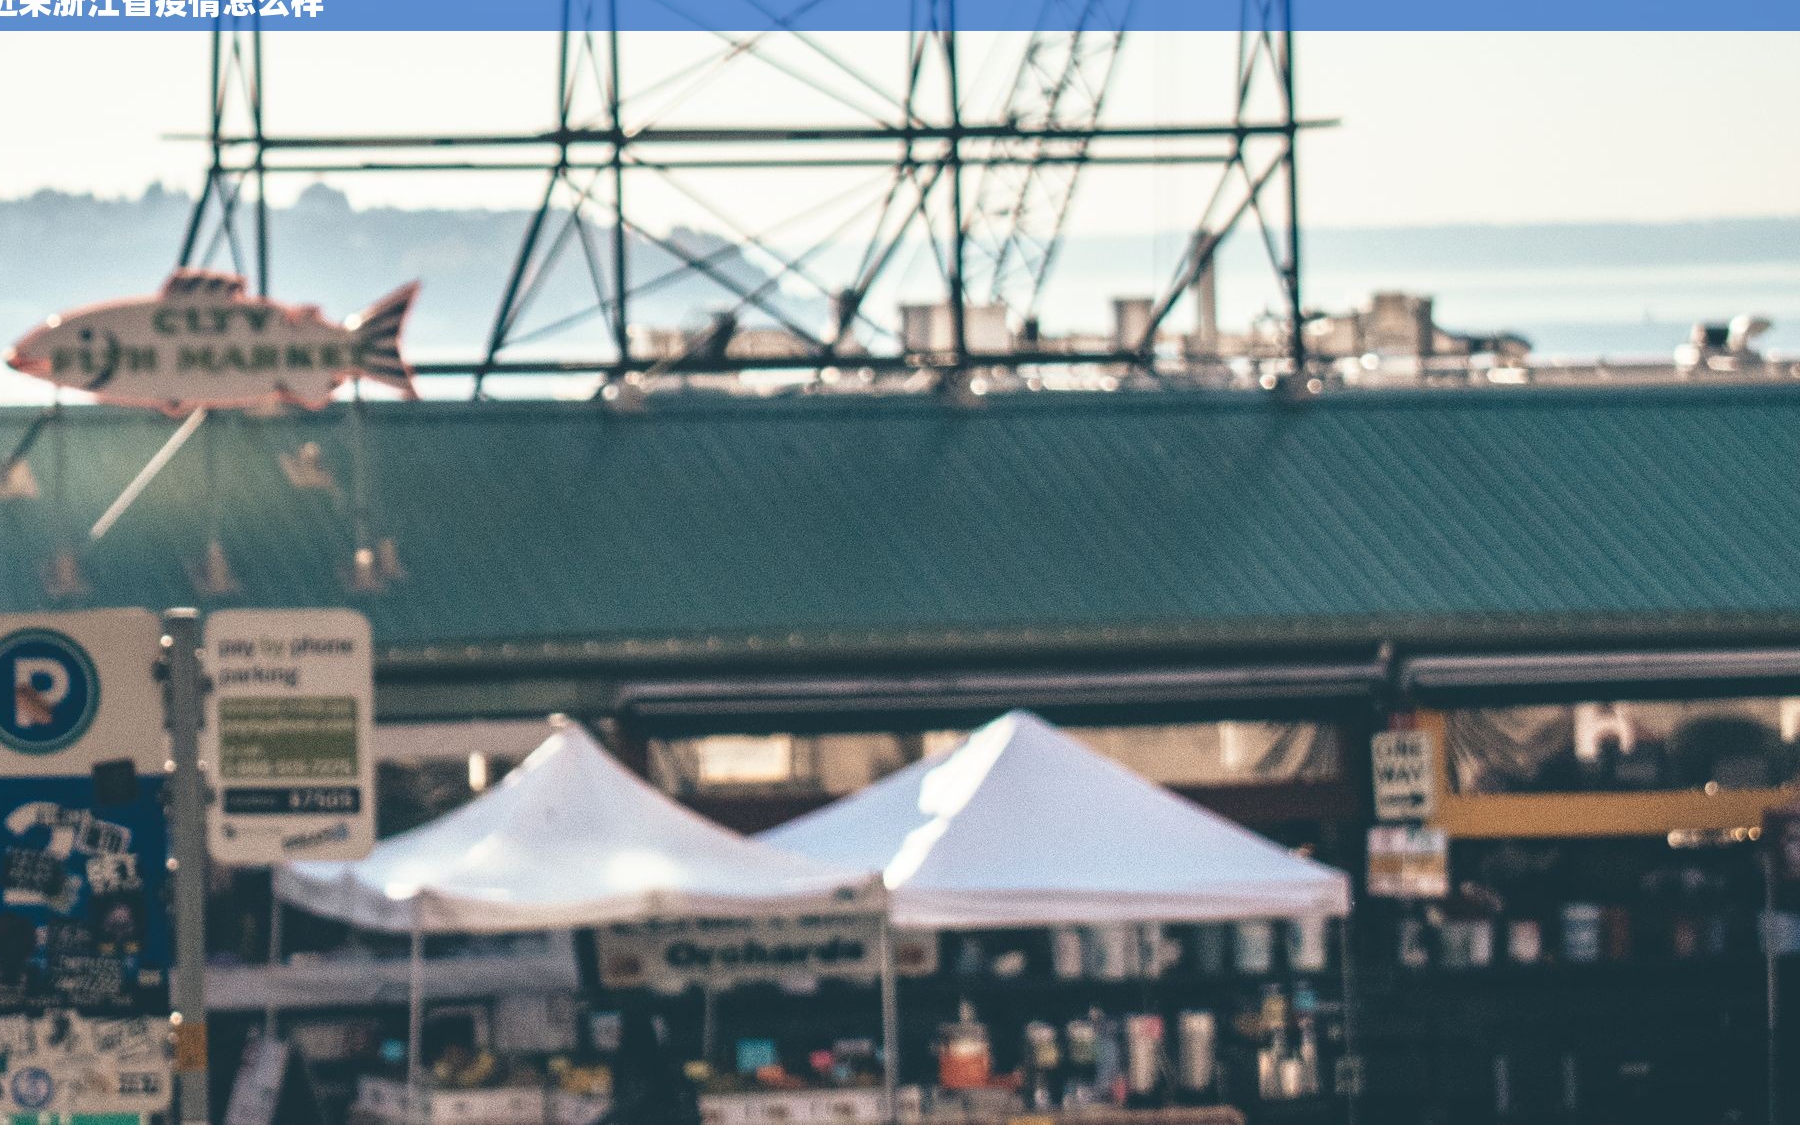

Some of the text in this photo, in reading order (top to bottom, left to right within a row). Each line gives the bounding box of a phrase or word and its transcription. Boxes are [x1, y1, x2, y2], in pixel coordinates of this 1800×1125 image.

[151, 307, 273, 335] CITY
[219, 640, 253, 658] pay
[290, 636, 354, 657] phone
[219, 666, 299, 687] parking
